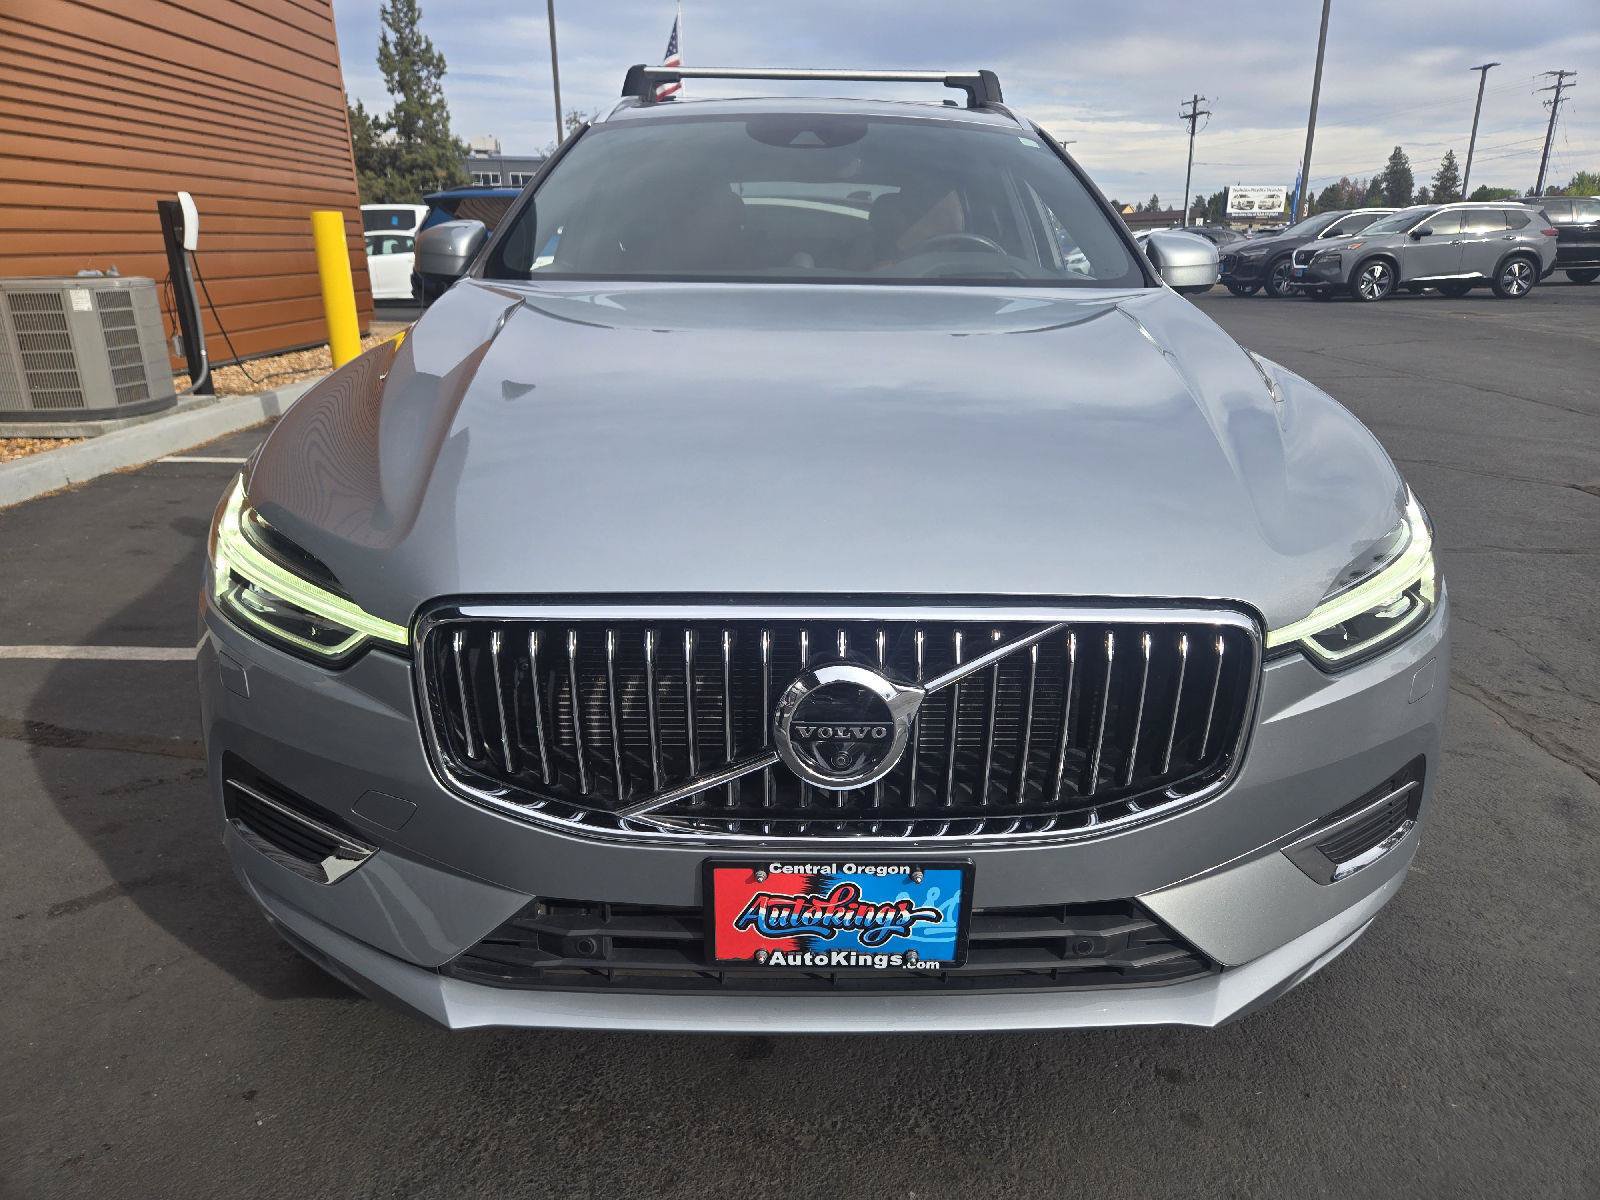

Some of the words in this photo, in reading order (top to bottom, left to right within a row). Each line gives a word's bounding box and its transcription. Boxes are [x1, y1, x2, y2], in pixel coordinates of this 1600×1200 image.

[795, 726, 887, 739] VOLVO
[769, 862, 836, 875] Central
[842, 863, 910, 877] Oregon
